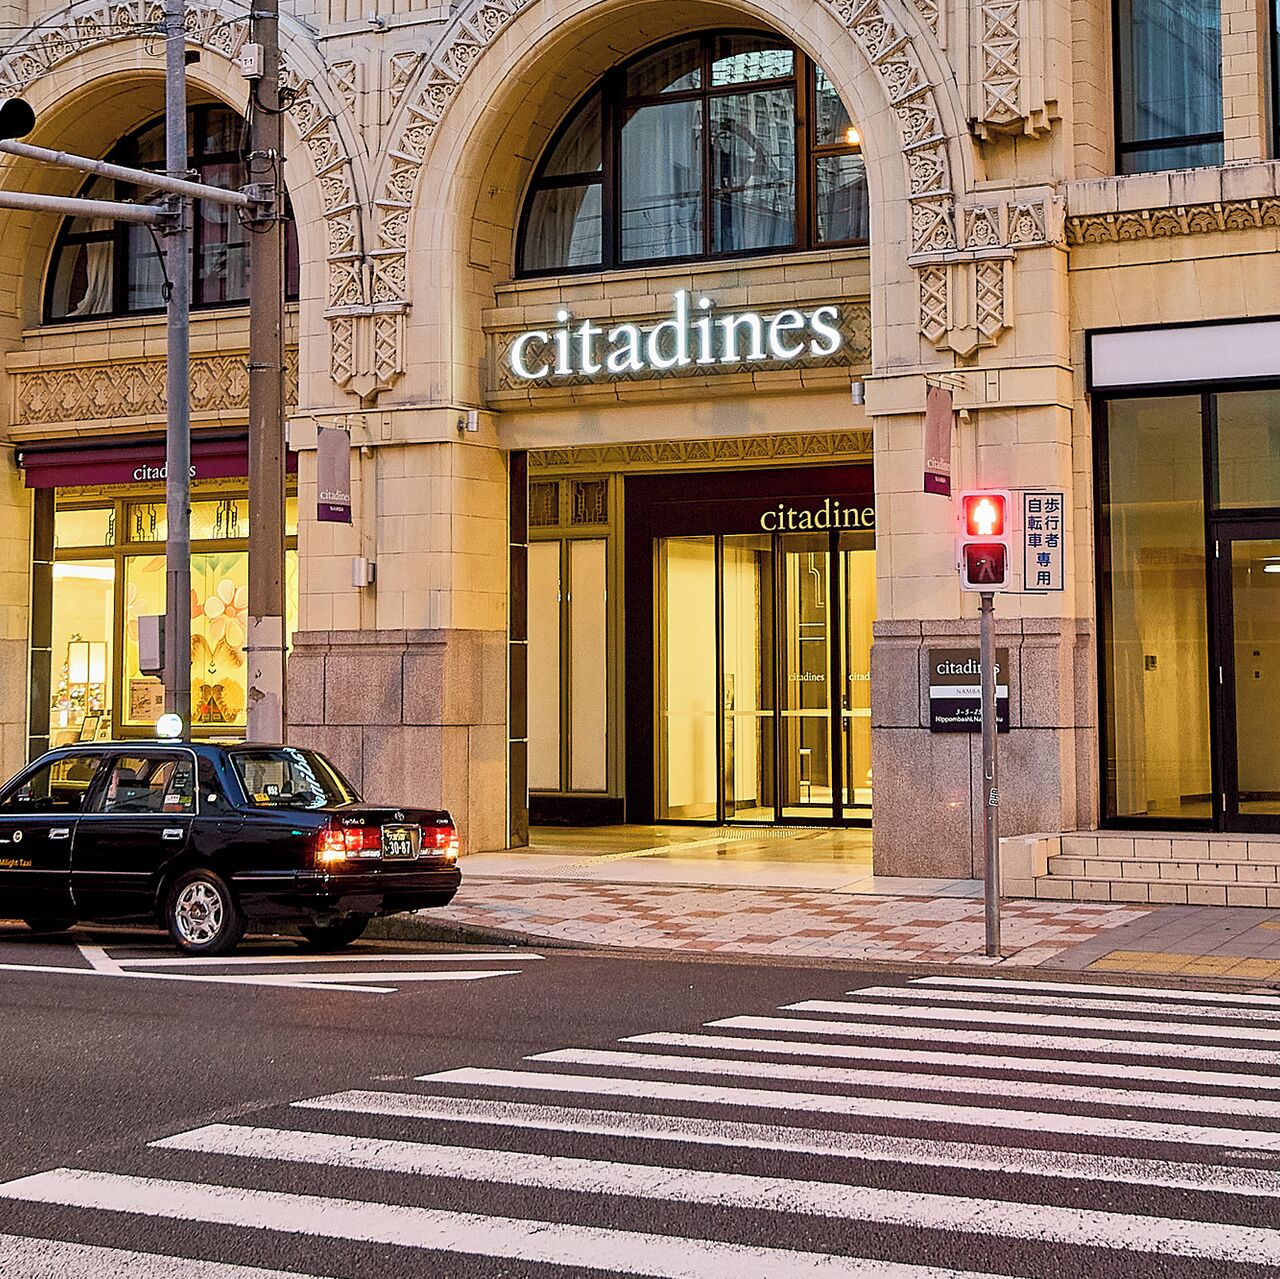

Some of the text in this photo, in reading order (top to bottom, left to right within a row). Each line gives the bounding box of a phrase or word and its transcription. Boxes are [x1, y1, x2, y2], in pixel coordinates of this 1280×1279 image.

[510, 289, 843, 380] citadines
[134, 462, 197, 481] citads
[760, 497, 875, 531] citadine
[1027, 498, 1043, 548] 自転車
[1044, 498, 1060, 548] 歩行者
[1036, 551, 1051, 586] 専用
[848, 670, 871, 681] citad
[936, 658, 1001, 675] citadis
